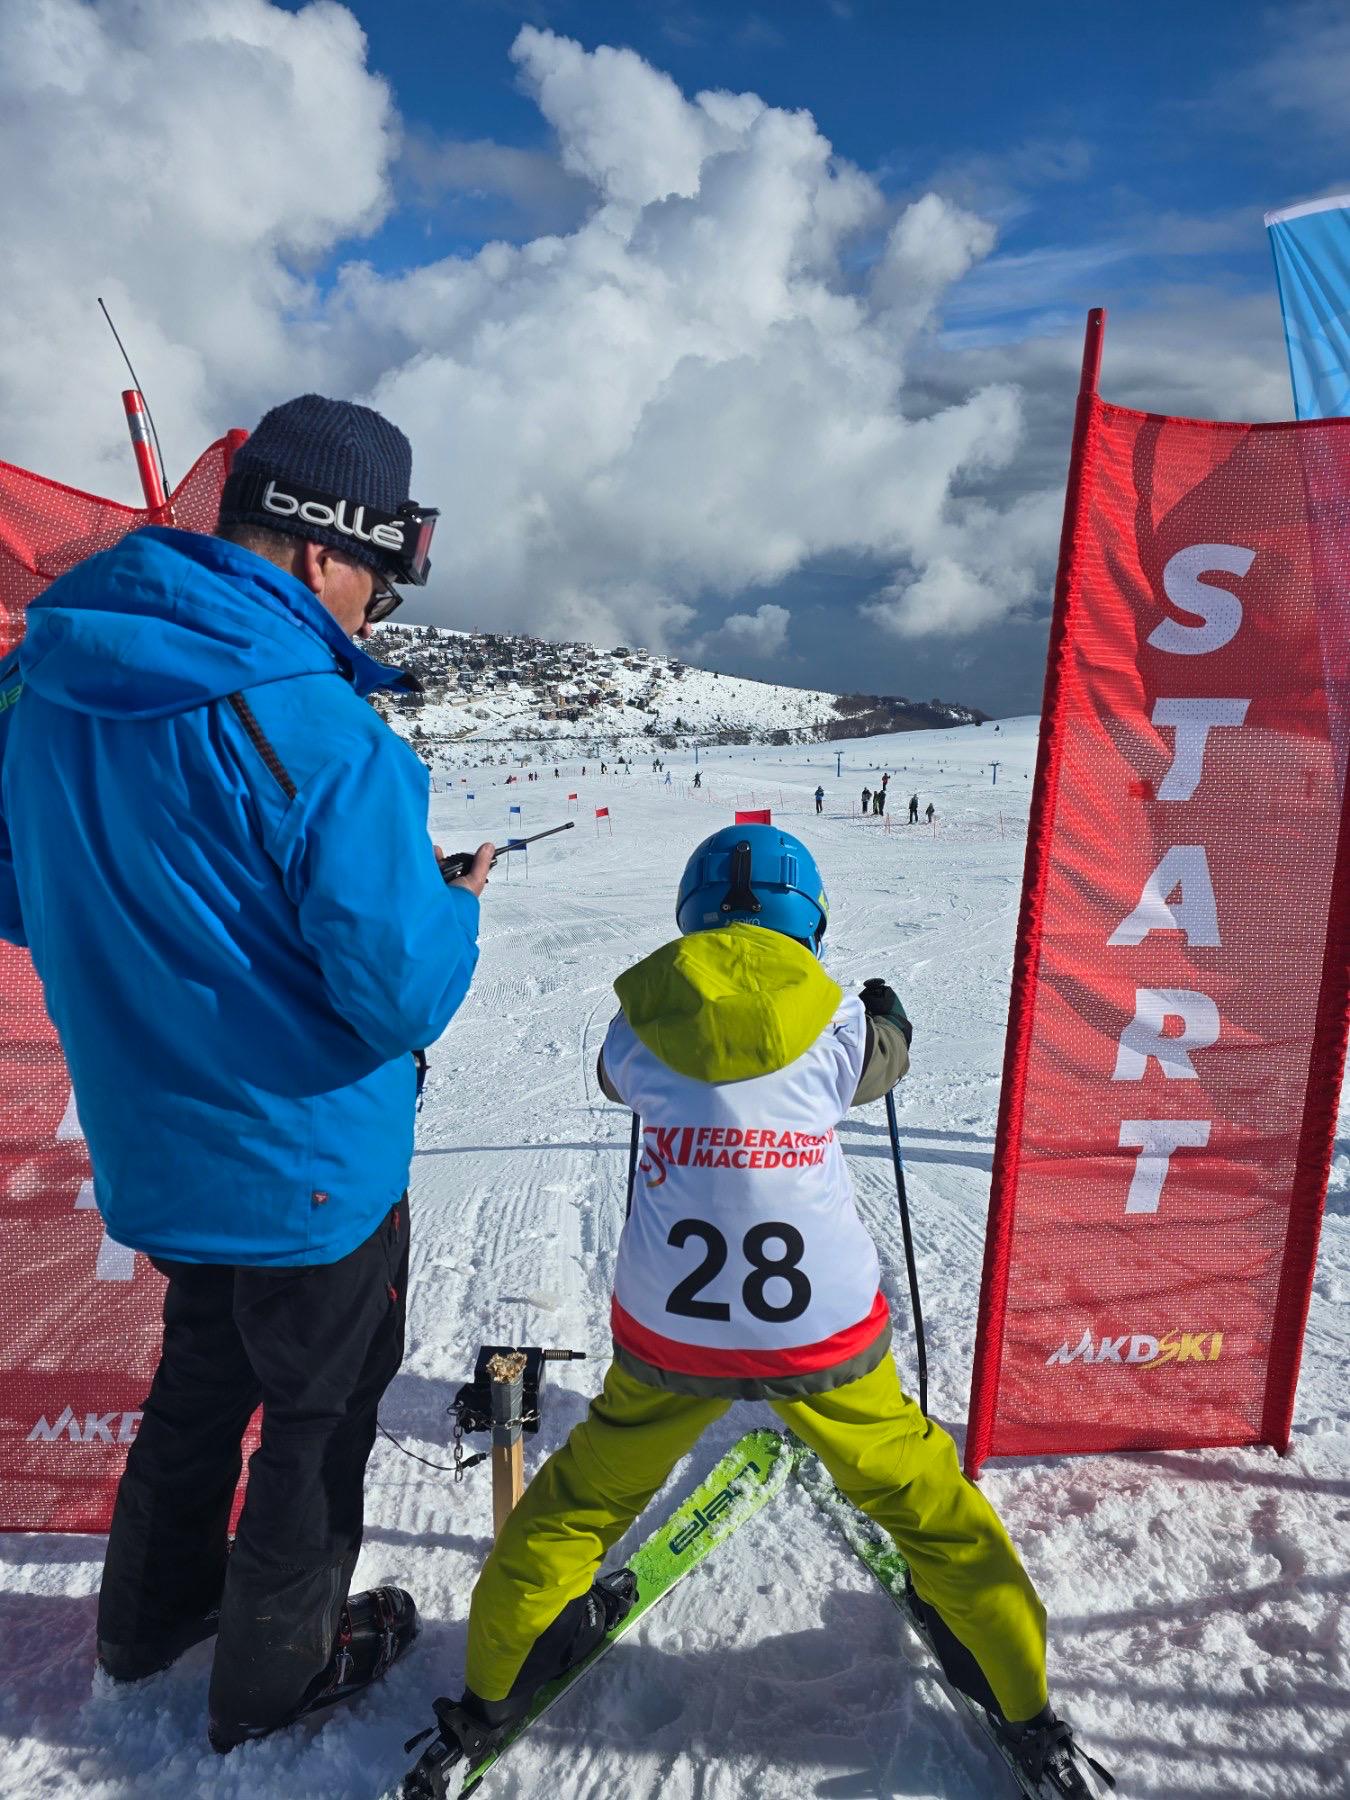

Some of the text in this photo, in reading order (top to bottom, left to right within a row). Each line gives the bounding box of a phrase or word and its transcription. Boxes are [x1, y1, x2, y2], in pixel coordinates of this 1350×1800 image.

[263, 480, 405, 550] bollé
[1107, 543, 1256, 1213] START
[640, 1126, 694, 1188] SKI
[692, 1149, 825, 1169] MACEDONIA
[665, 1218, 812, 1323] 28
